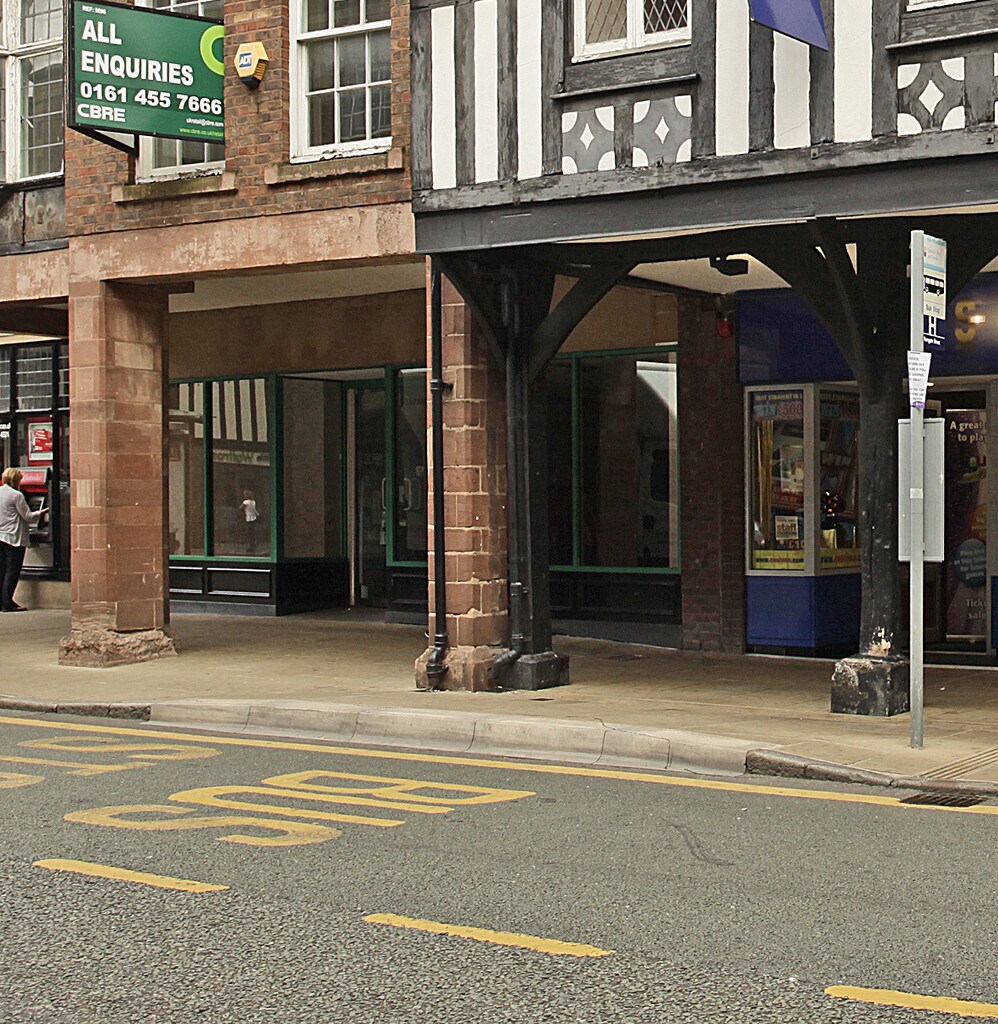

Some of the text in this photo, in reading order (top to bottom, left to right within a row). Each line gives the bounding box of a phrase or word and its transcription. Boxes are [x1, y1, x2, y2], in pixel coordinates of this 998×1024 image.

[81, 19, 122, 45] ALL
[81, 50, 194, 86] ENQUIRIES
[80, 82, 222, 115] 0161 455 7666
[77, 103, 126, 123] CBRE
[950, 420, 957, 430] A
[958, 433, 967, 442] to
[63, 770, 538, 848] BUS
